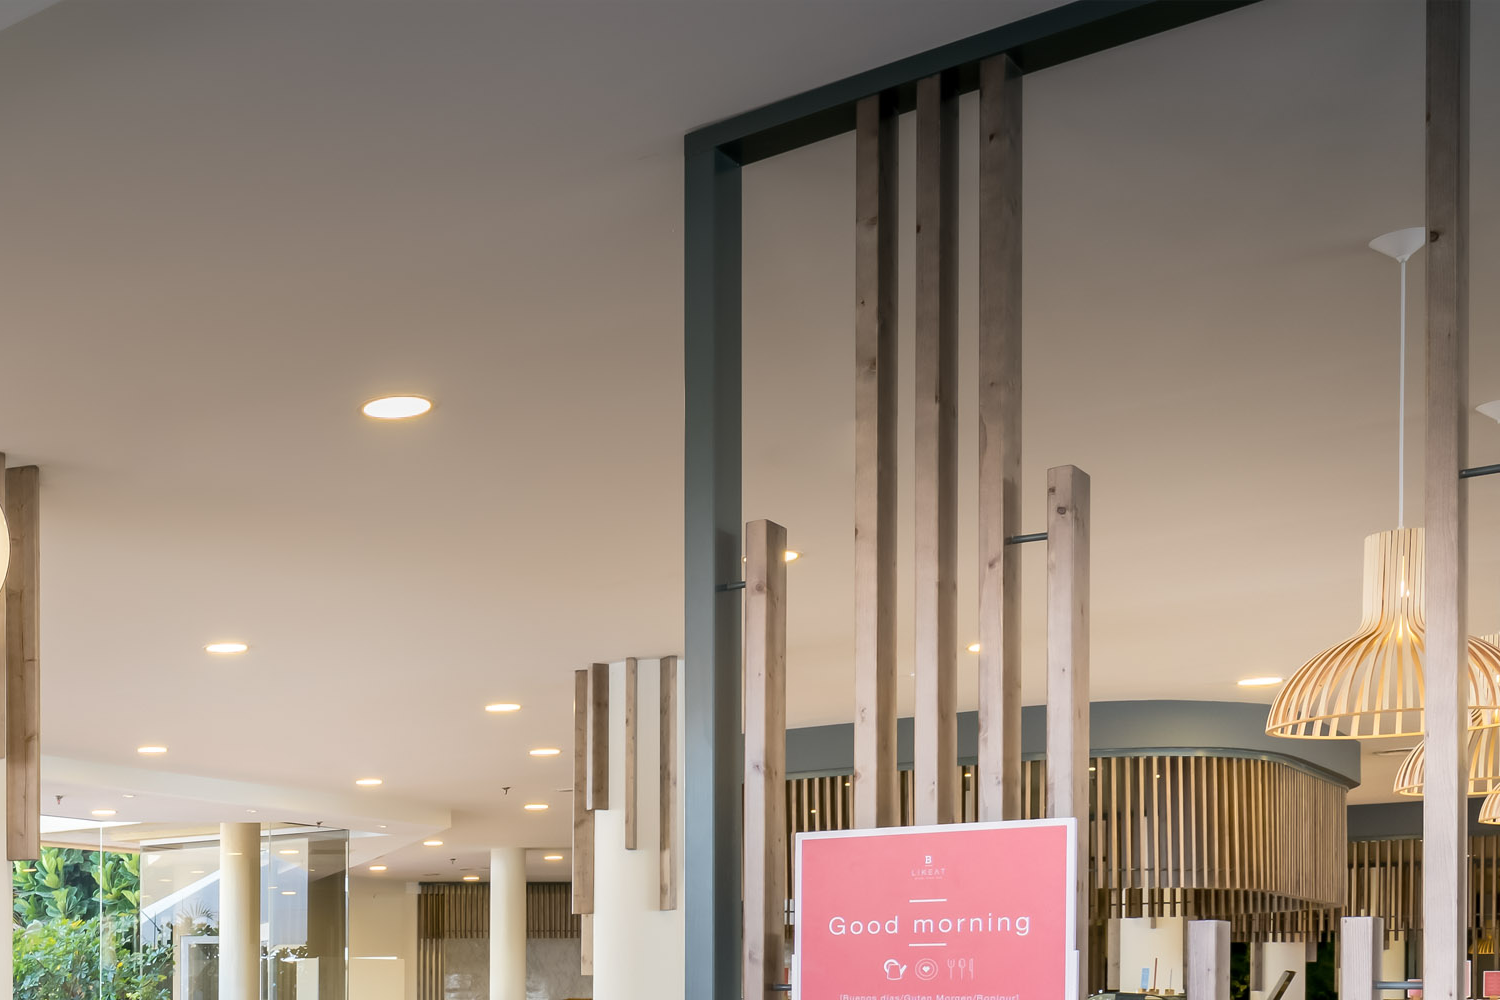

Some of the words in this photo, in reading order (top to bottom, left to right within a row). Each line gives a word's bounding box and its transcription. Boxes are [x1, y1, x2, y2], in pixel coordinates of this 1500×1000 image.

[924, 855, 932, 864] B
[829, 916, 898, 936] Good
[913, 913, 1030, 936] morning
